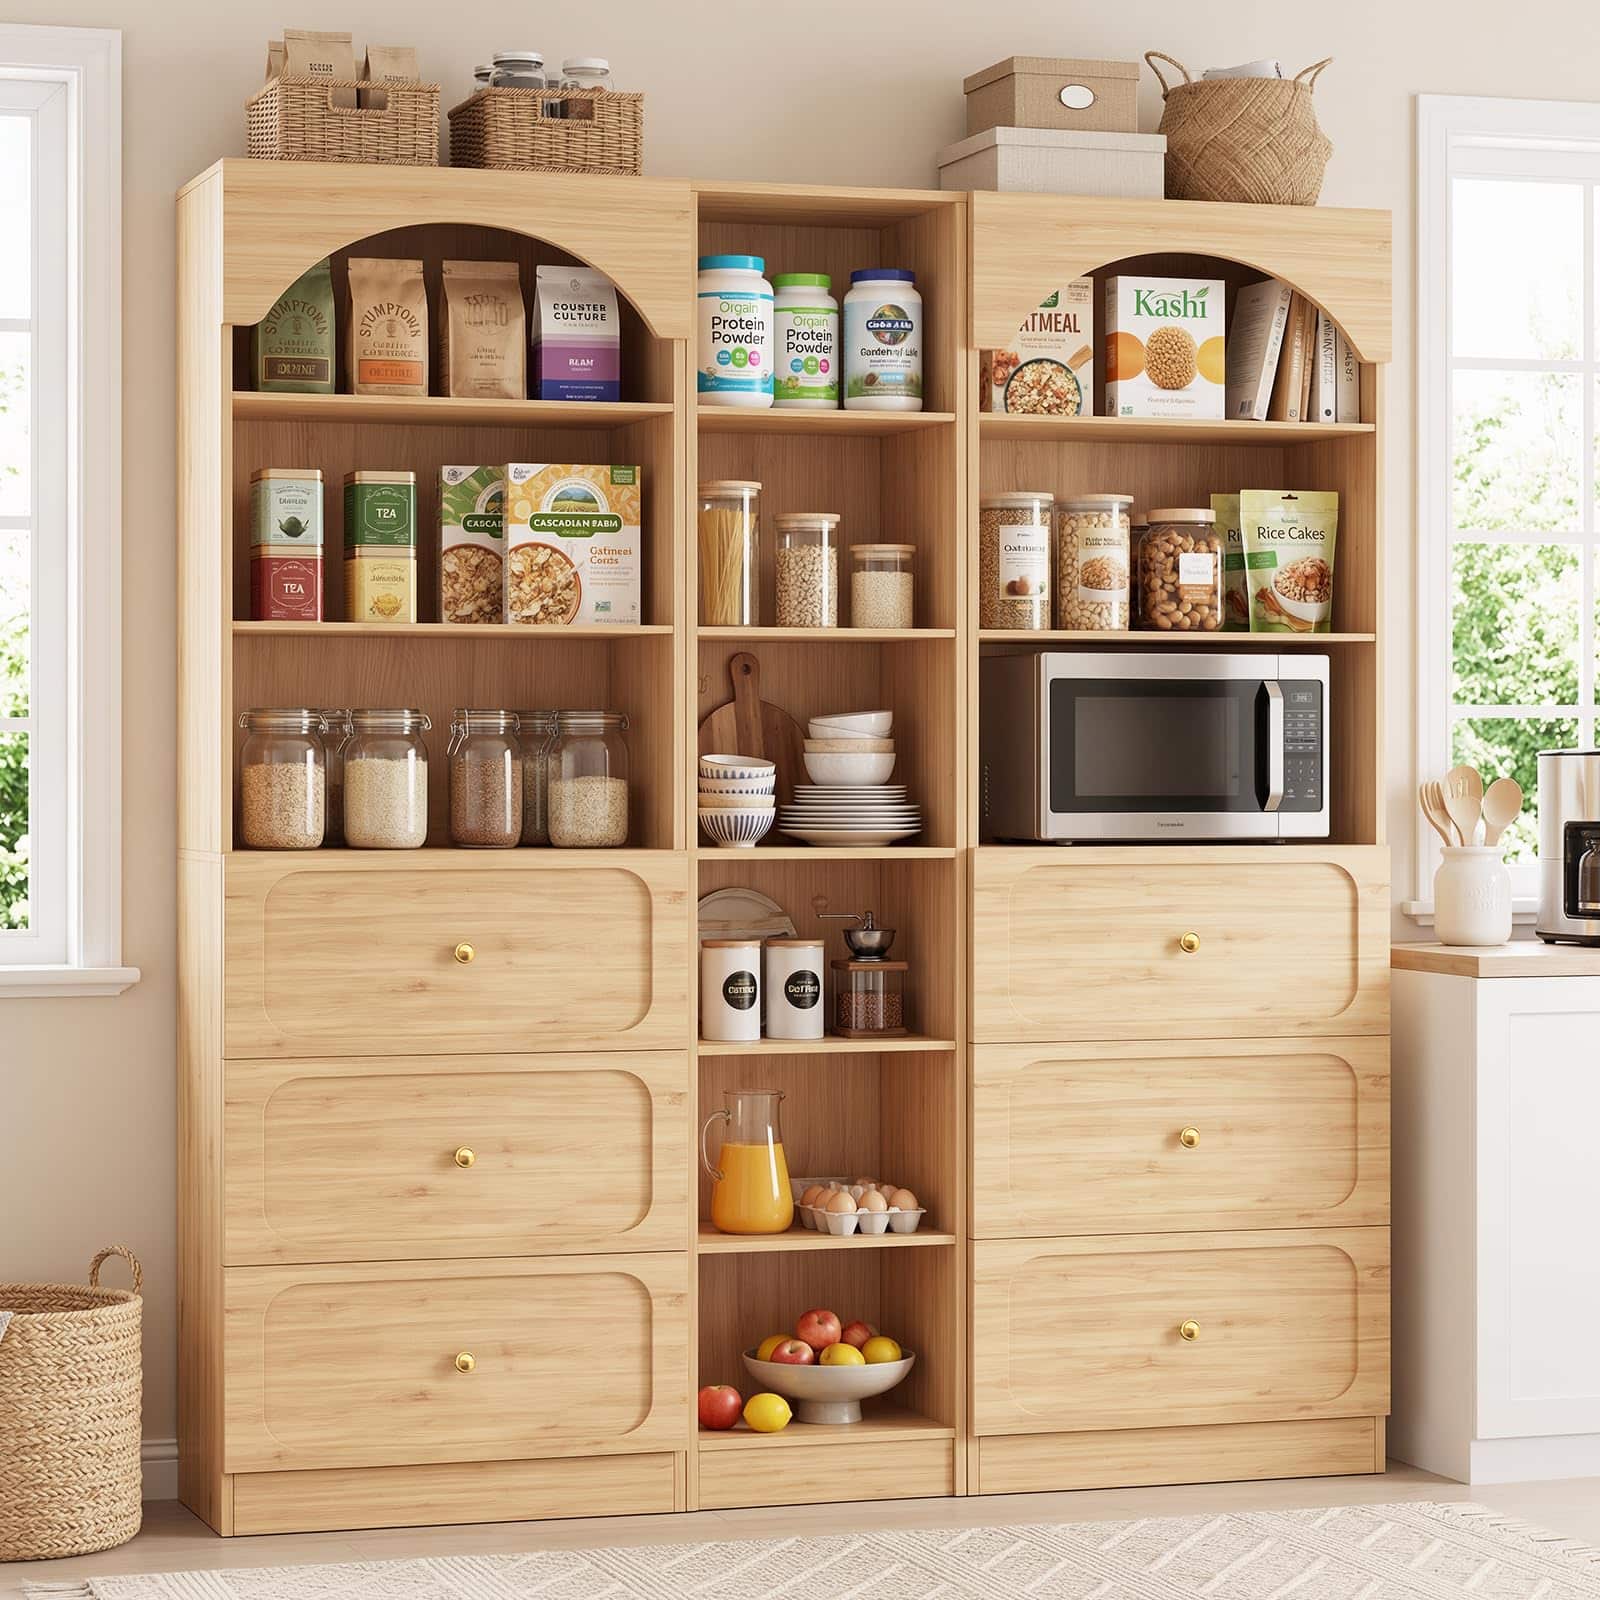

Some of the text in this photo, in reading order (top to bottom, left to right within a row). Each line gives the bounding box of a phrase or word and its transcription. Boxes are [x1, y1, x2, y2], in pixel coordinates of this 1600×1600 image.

[720, 301, 759, 316] Orgain
[1133, 287, 1209, 319] Kashi
[554, 312, 607, 321] CULTURE
[711, 316, 765, 331] Protein
[792, 315, 828, 329] Orgain
[711, 331, 765, 345] Powder
[786, 328, 833, 342] Protein
[786, 341, 833, 354] Powder
[533, 519, 590, 528] CASCADIAN
[1257, 526, 1326, 541] Rice Cakes
